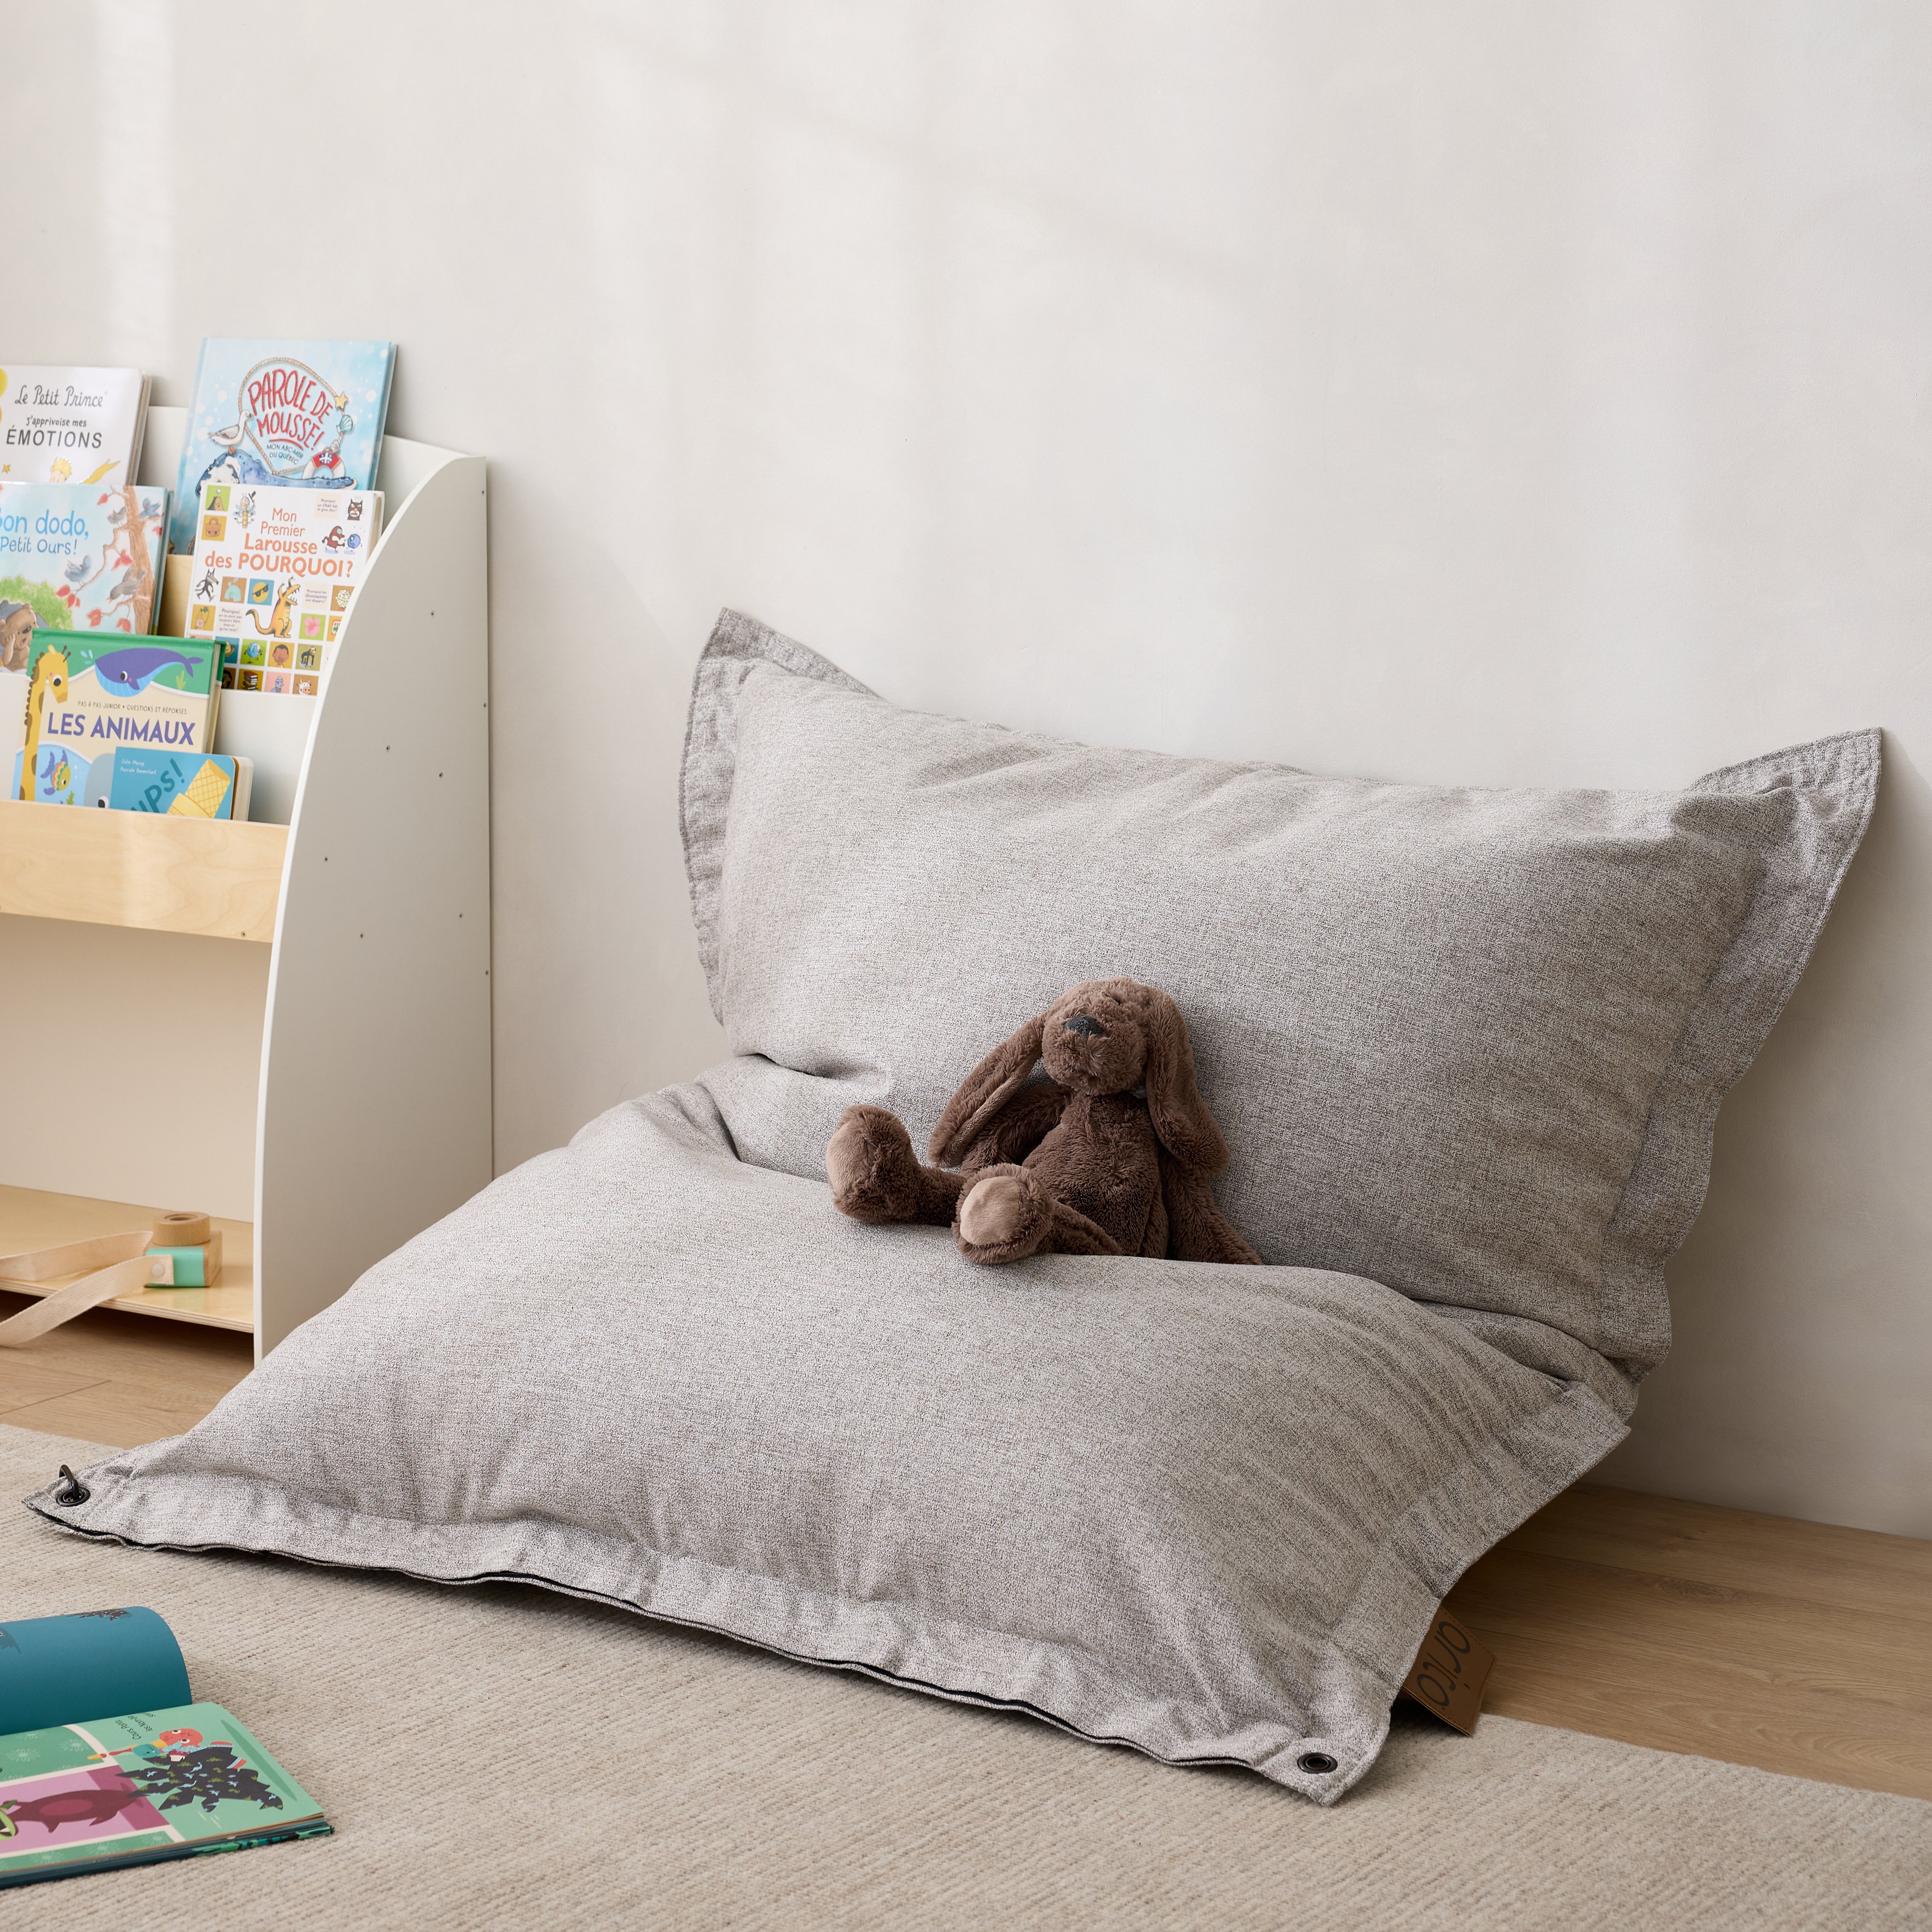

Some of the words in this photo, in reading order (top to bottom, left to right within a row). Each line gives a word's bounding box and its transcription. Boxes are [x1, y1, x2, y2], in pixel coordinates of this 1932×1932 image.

[15, 385, 28, 404] Le
[33, 385, 59, 405] Petit
[64, 386, 103, 407] Prince
[248, 369, 316, 416] PAROLE
[310, 391, 333, 424] DE
[6, 425, 102, 448] ÉMOTIONS
[256, 411, 324, 451] MOUSSE!
[281, 445, 304, 460] ABC-MER
[0, 506, 27, 534] on
[36, 509, 88, 540] dodo,
[272, 507, 297, 522] Mon
[261, 521, 305, 537] Premier
[0, 536, 31, 553] Petit
[244, 532, 318, 554] Larousse
[205, 551, 232, 568] des
[48, 712, 86, 736] LES
[90, 715, 196, 745] ANIMAUX
